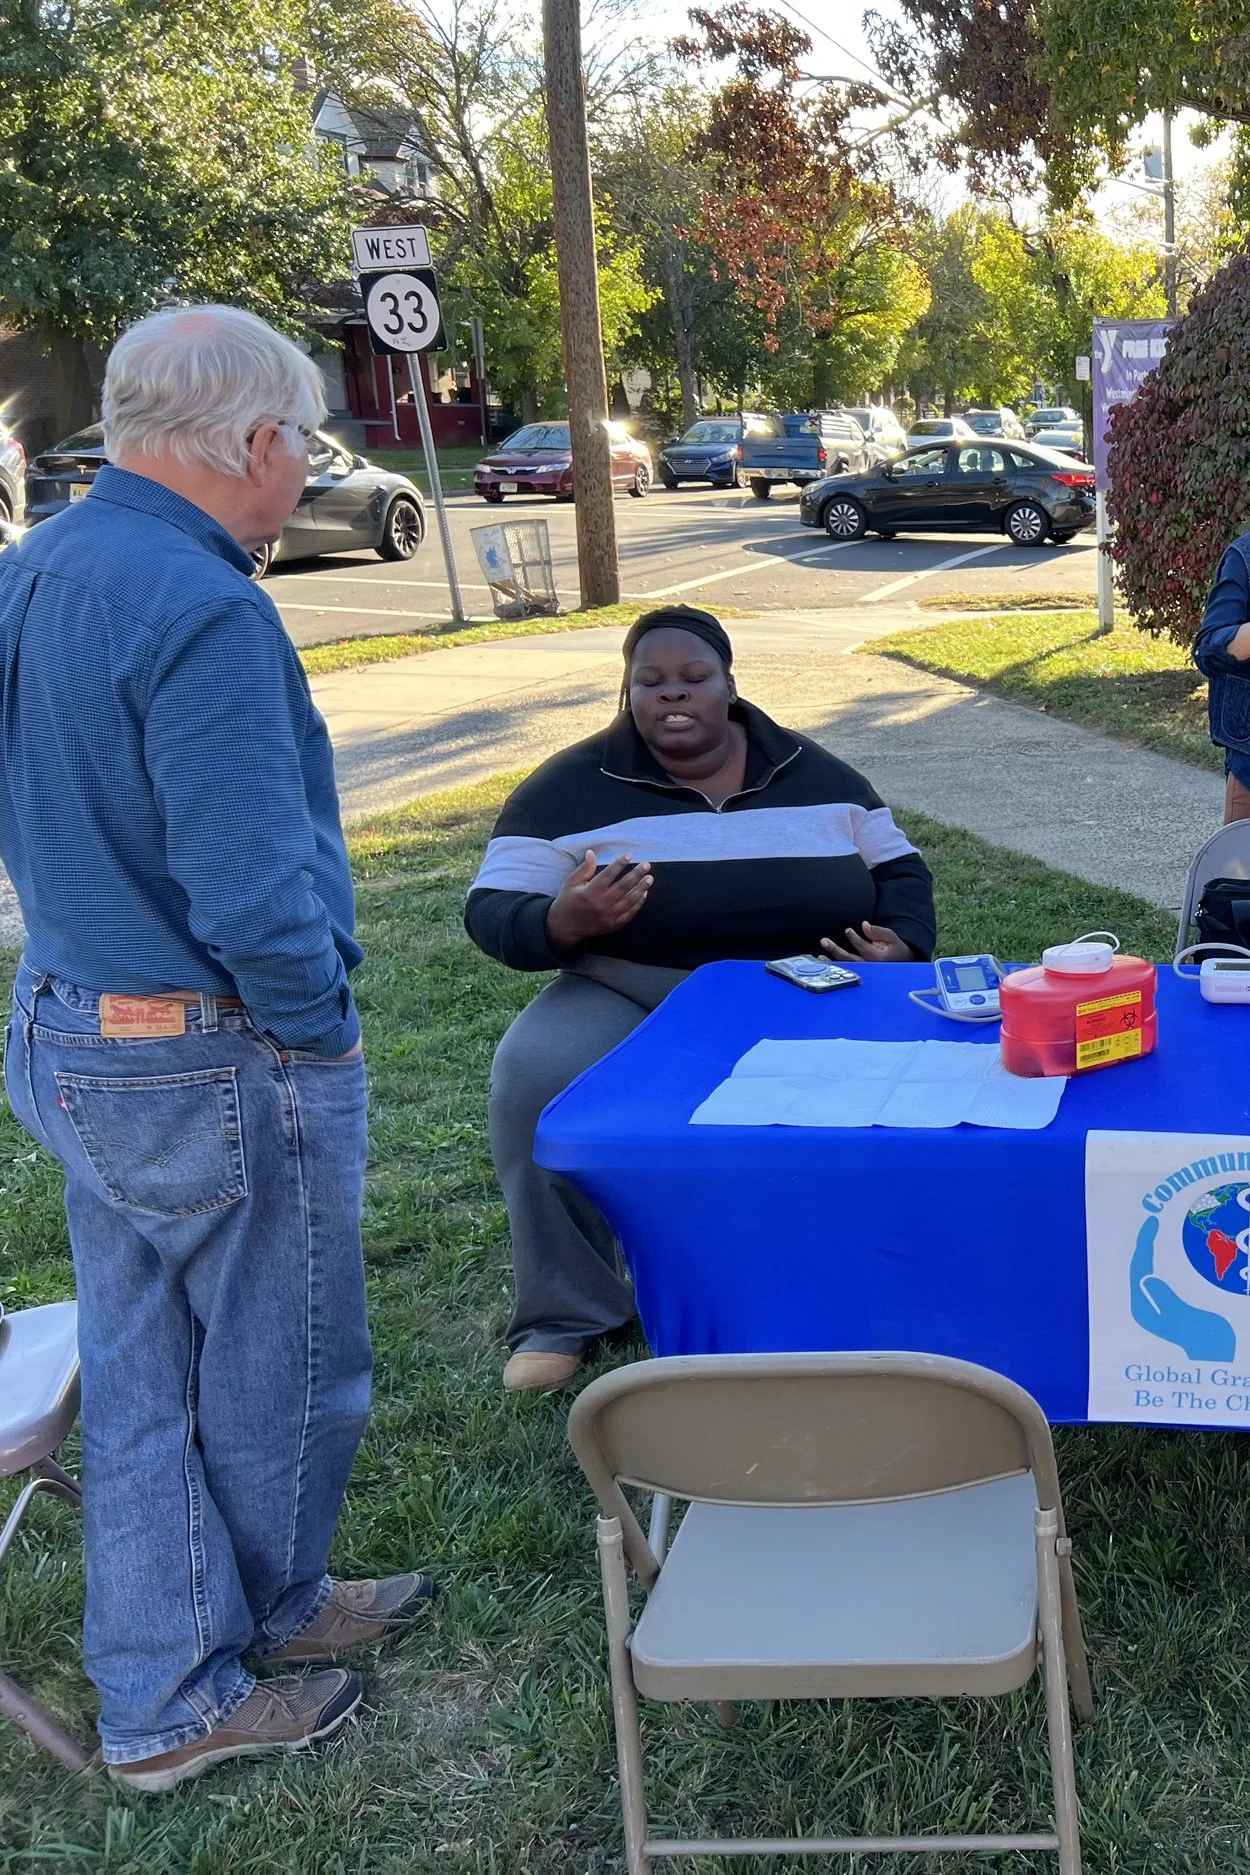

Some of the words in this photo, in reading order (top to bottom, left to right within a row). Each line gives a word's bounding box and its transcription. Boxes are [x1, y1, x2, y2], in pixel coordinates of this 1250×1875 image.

[365, 238, 416, 259] WEST
[380, 290, 428, 335] 33
[1125, 1364, 1201, 1384] Global
[1134, 1390, 1163, 1407] Be
[1171, 1391, 1217, 1409] The
